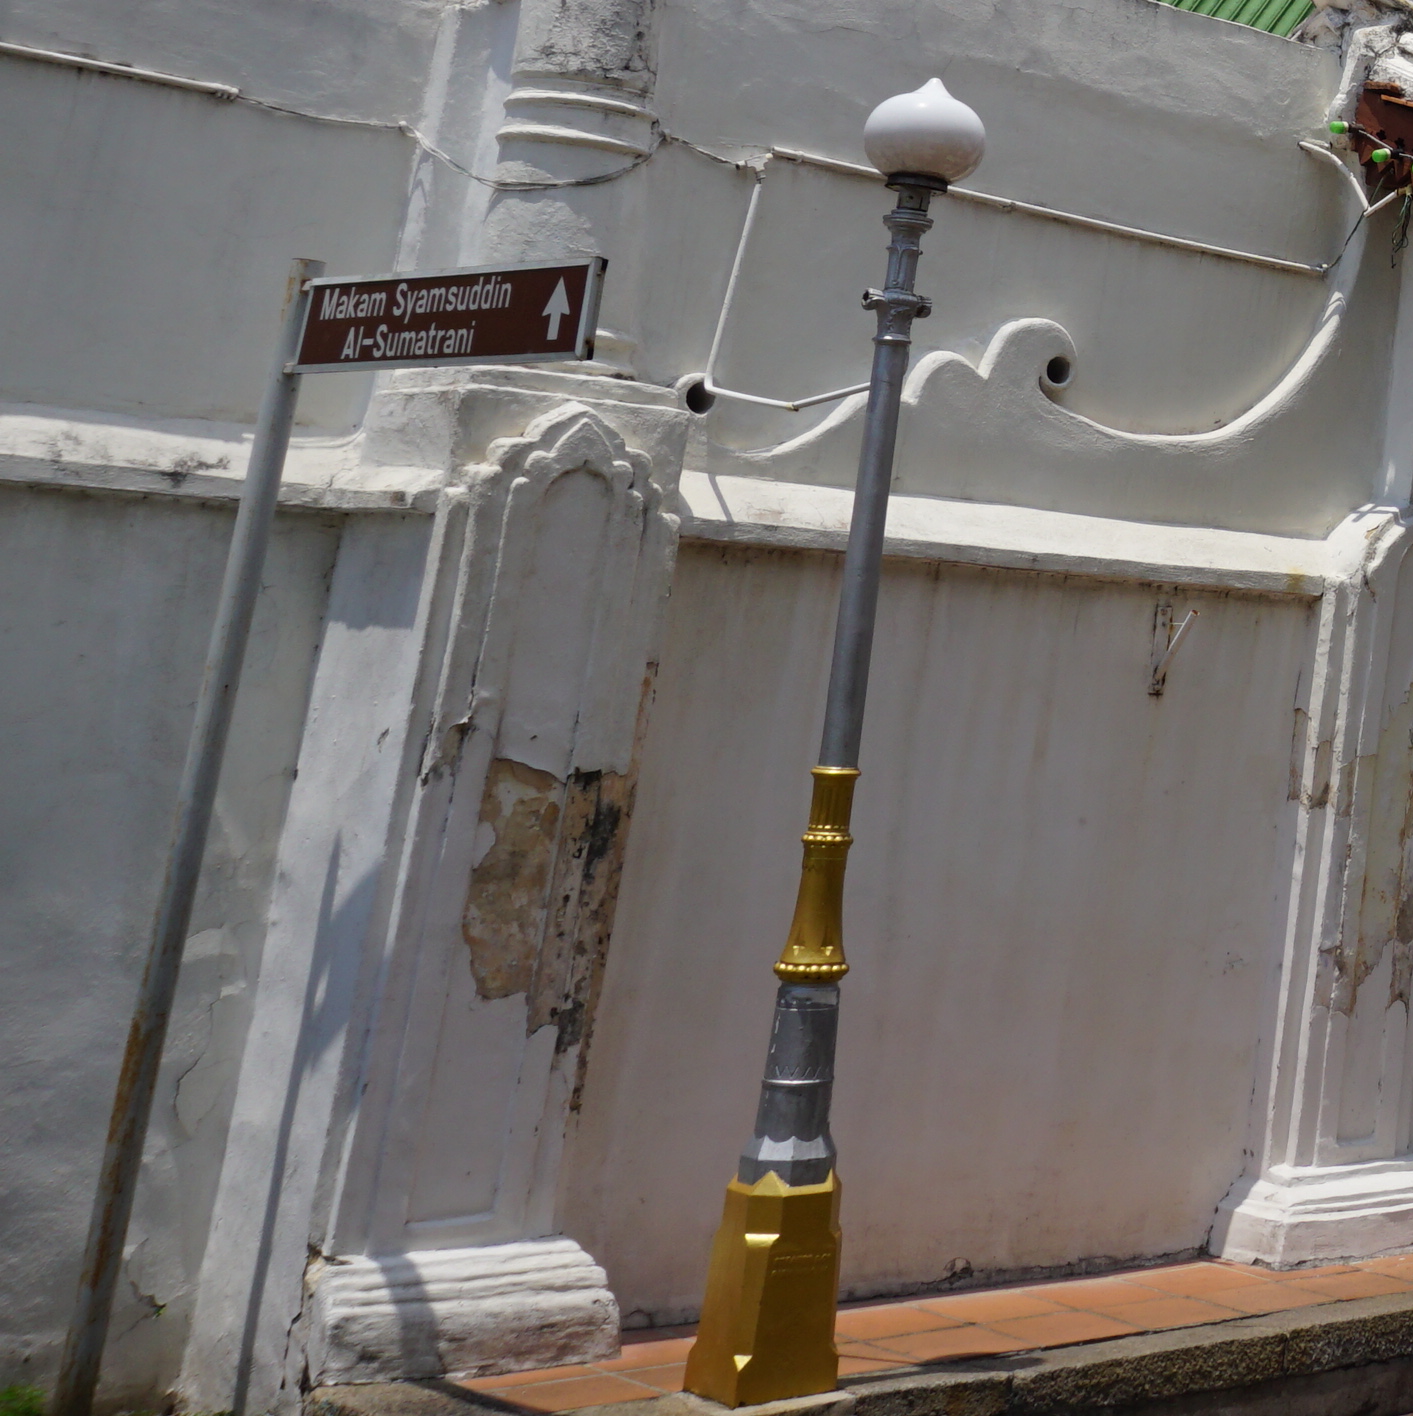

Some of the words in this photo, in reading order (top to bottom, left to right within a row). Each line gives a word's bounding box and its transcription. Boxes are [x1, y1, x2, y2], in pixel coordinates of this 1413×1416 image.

[319, 286, 387, 321] Makam
[393, 276, 512, 324] Syamsuddin
[340, 320, 476, 360] Al-Sumatrani
